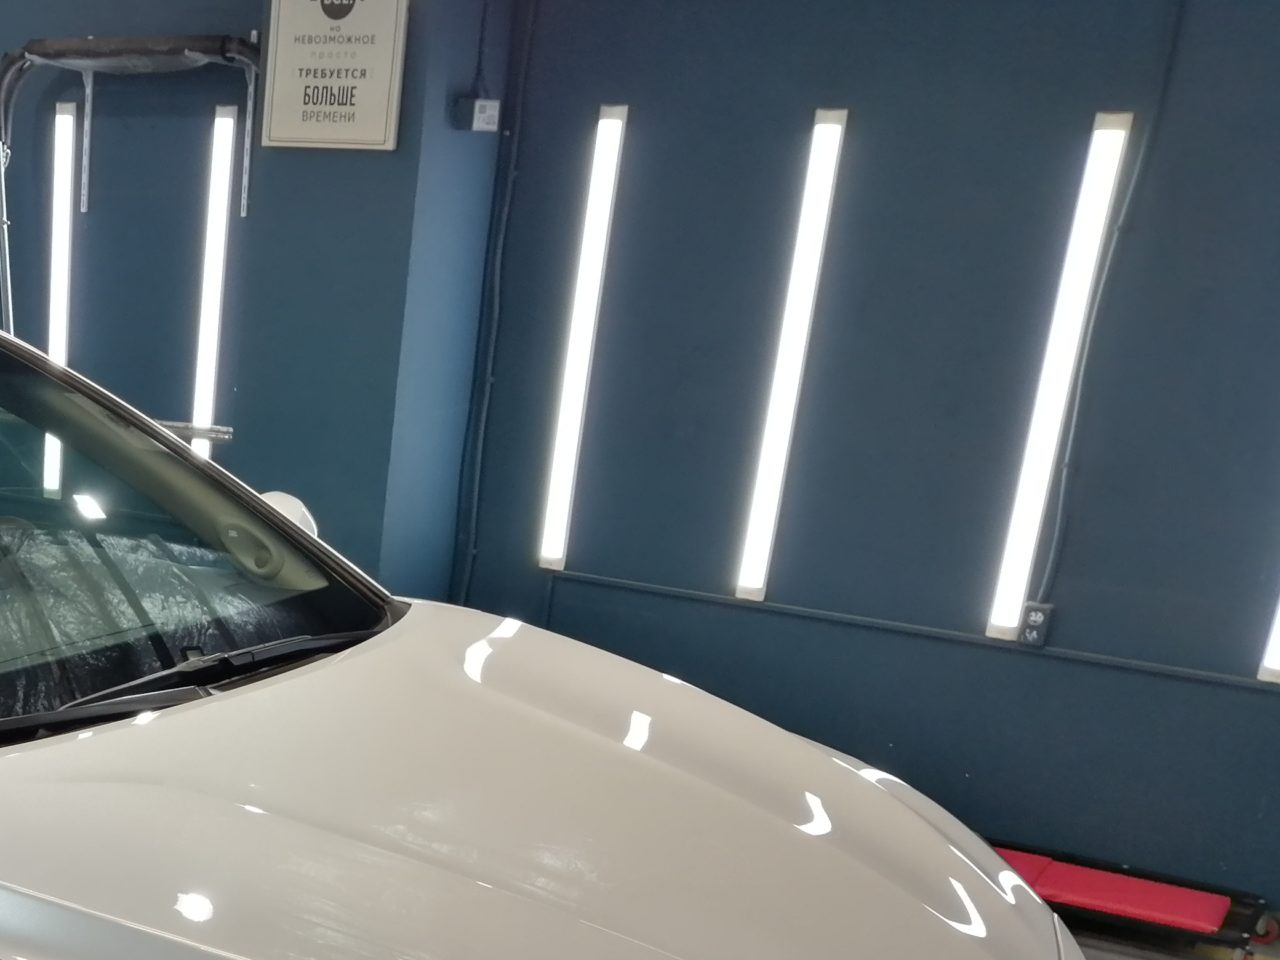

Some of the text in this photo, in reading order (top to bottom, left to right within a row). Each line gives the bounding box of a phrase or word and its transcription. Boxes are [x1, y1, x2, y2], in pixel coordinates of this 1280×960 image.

[293, 34, 377, 45] НЕВОЗМОЖНОЕ
[297, 67, 368, 80] ТРЕБУЕТСЯ
[302, 85, 358, 107] БОЛЬШЕ
[301, 110, 356, 123] ВРЕМЕНИ
